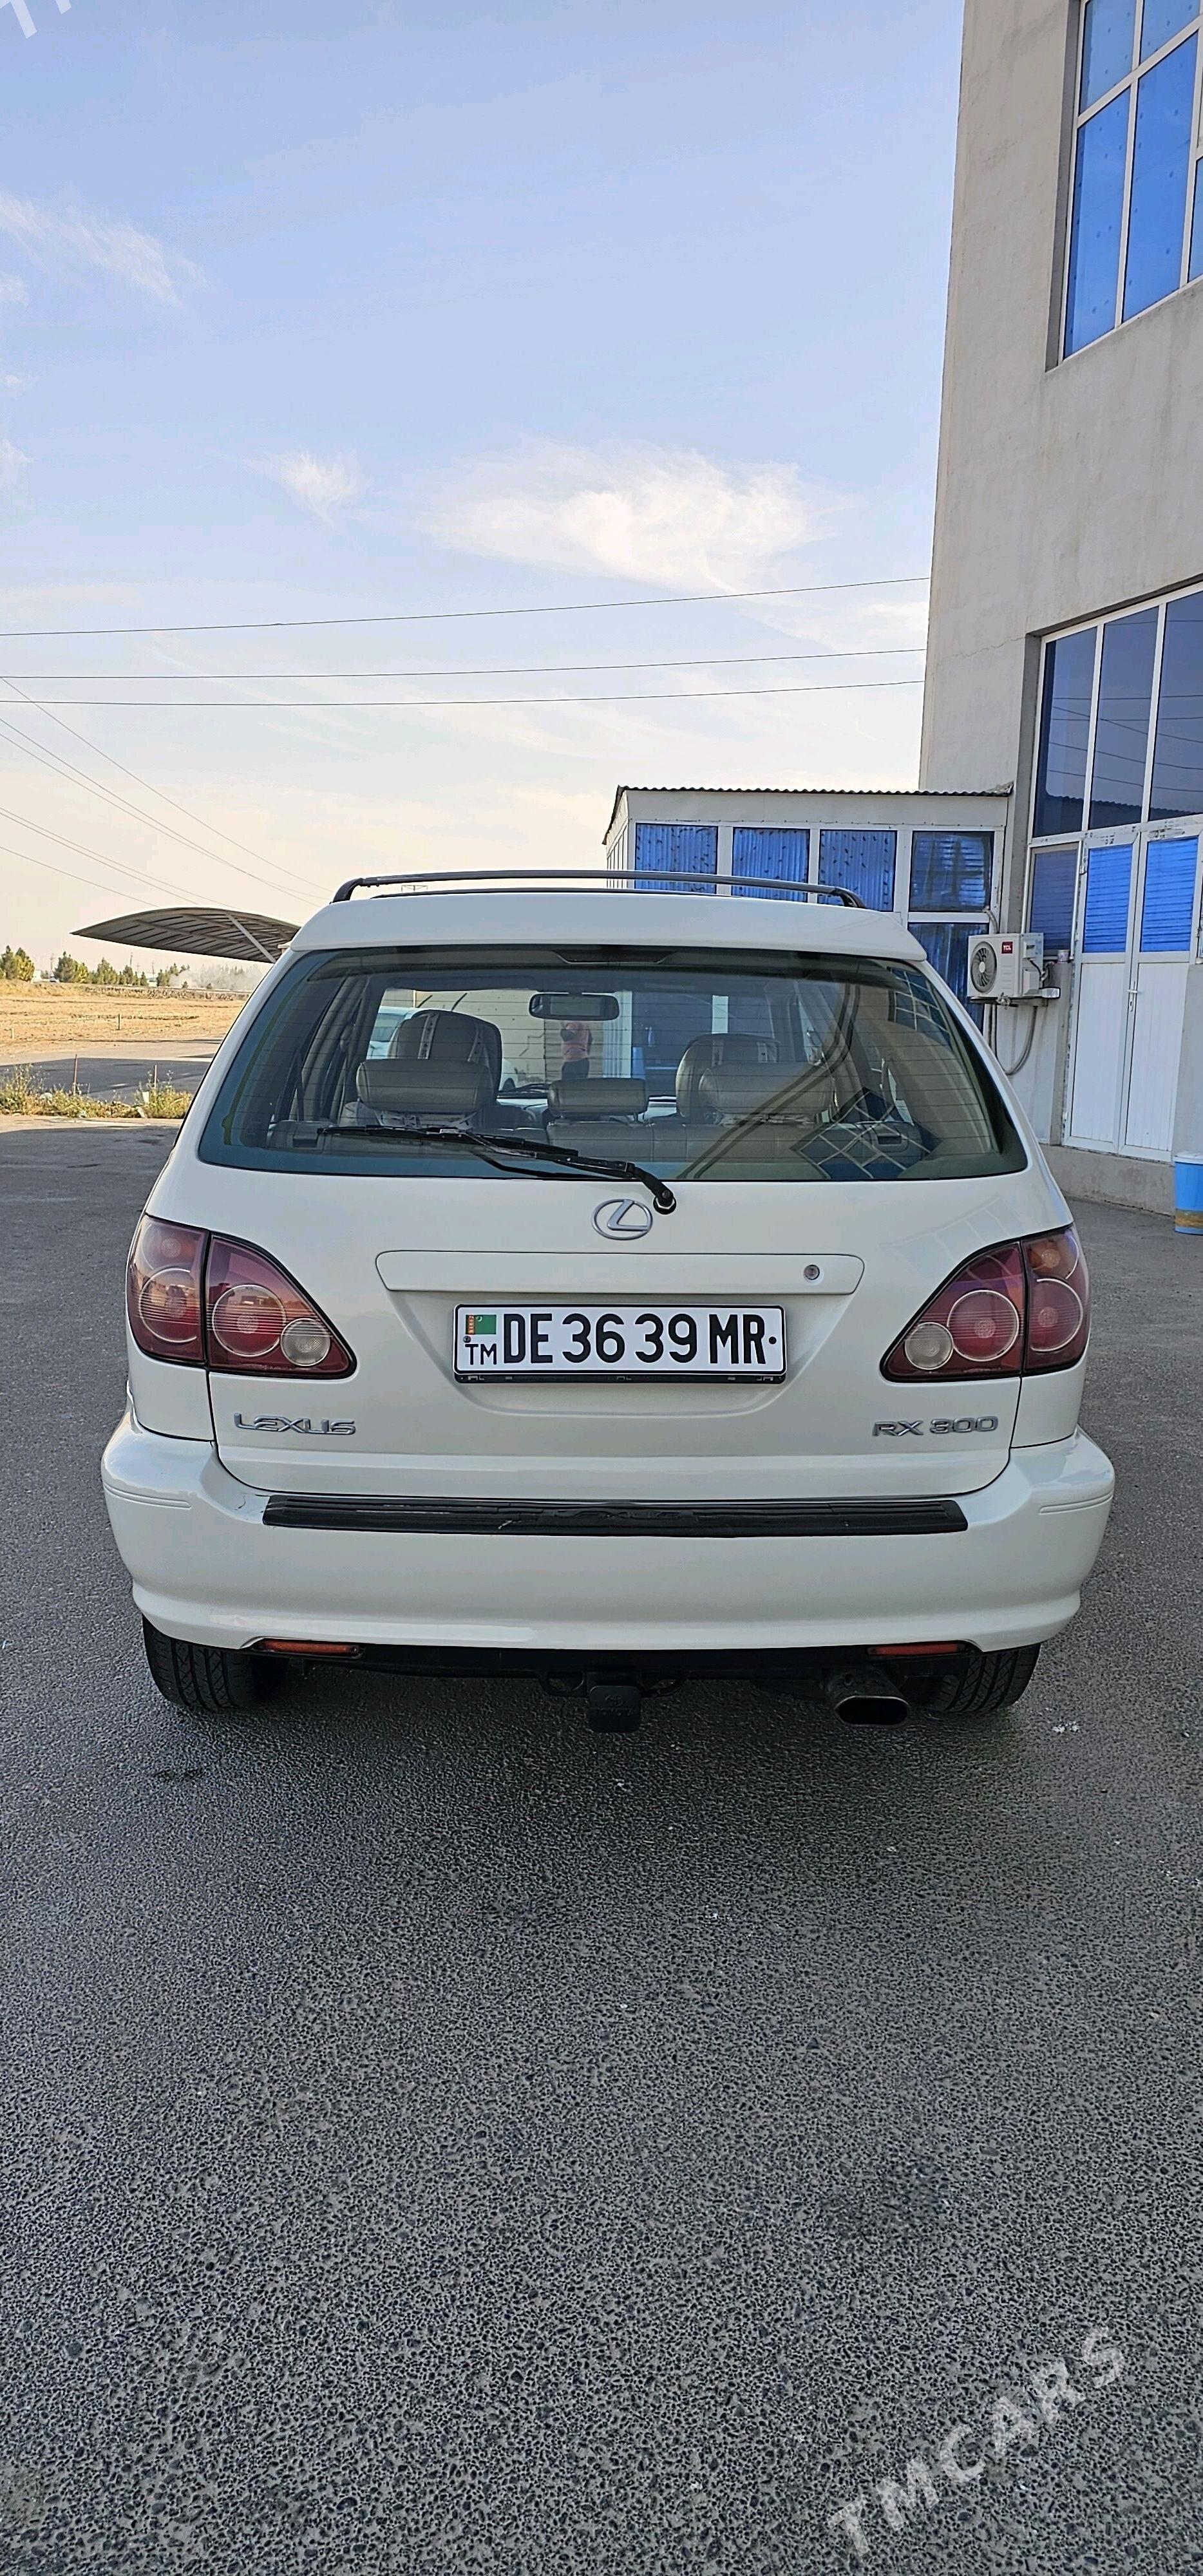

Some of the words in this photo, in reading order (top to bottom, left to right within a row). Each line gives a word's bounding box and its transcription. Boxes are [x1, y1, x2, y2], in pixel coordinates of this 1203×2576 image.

[503, 1313, 553, 1364] DE
[708, 1314, 766, 1364] MR
[465, 1343, 497, 1365] TM
[234, 1413, 356, 1435] LEXUS
[873, 1420, 924, 1437] RX
[929, 1416, 999, 1434] 300
